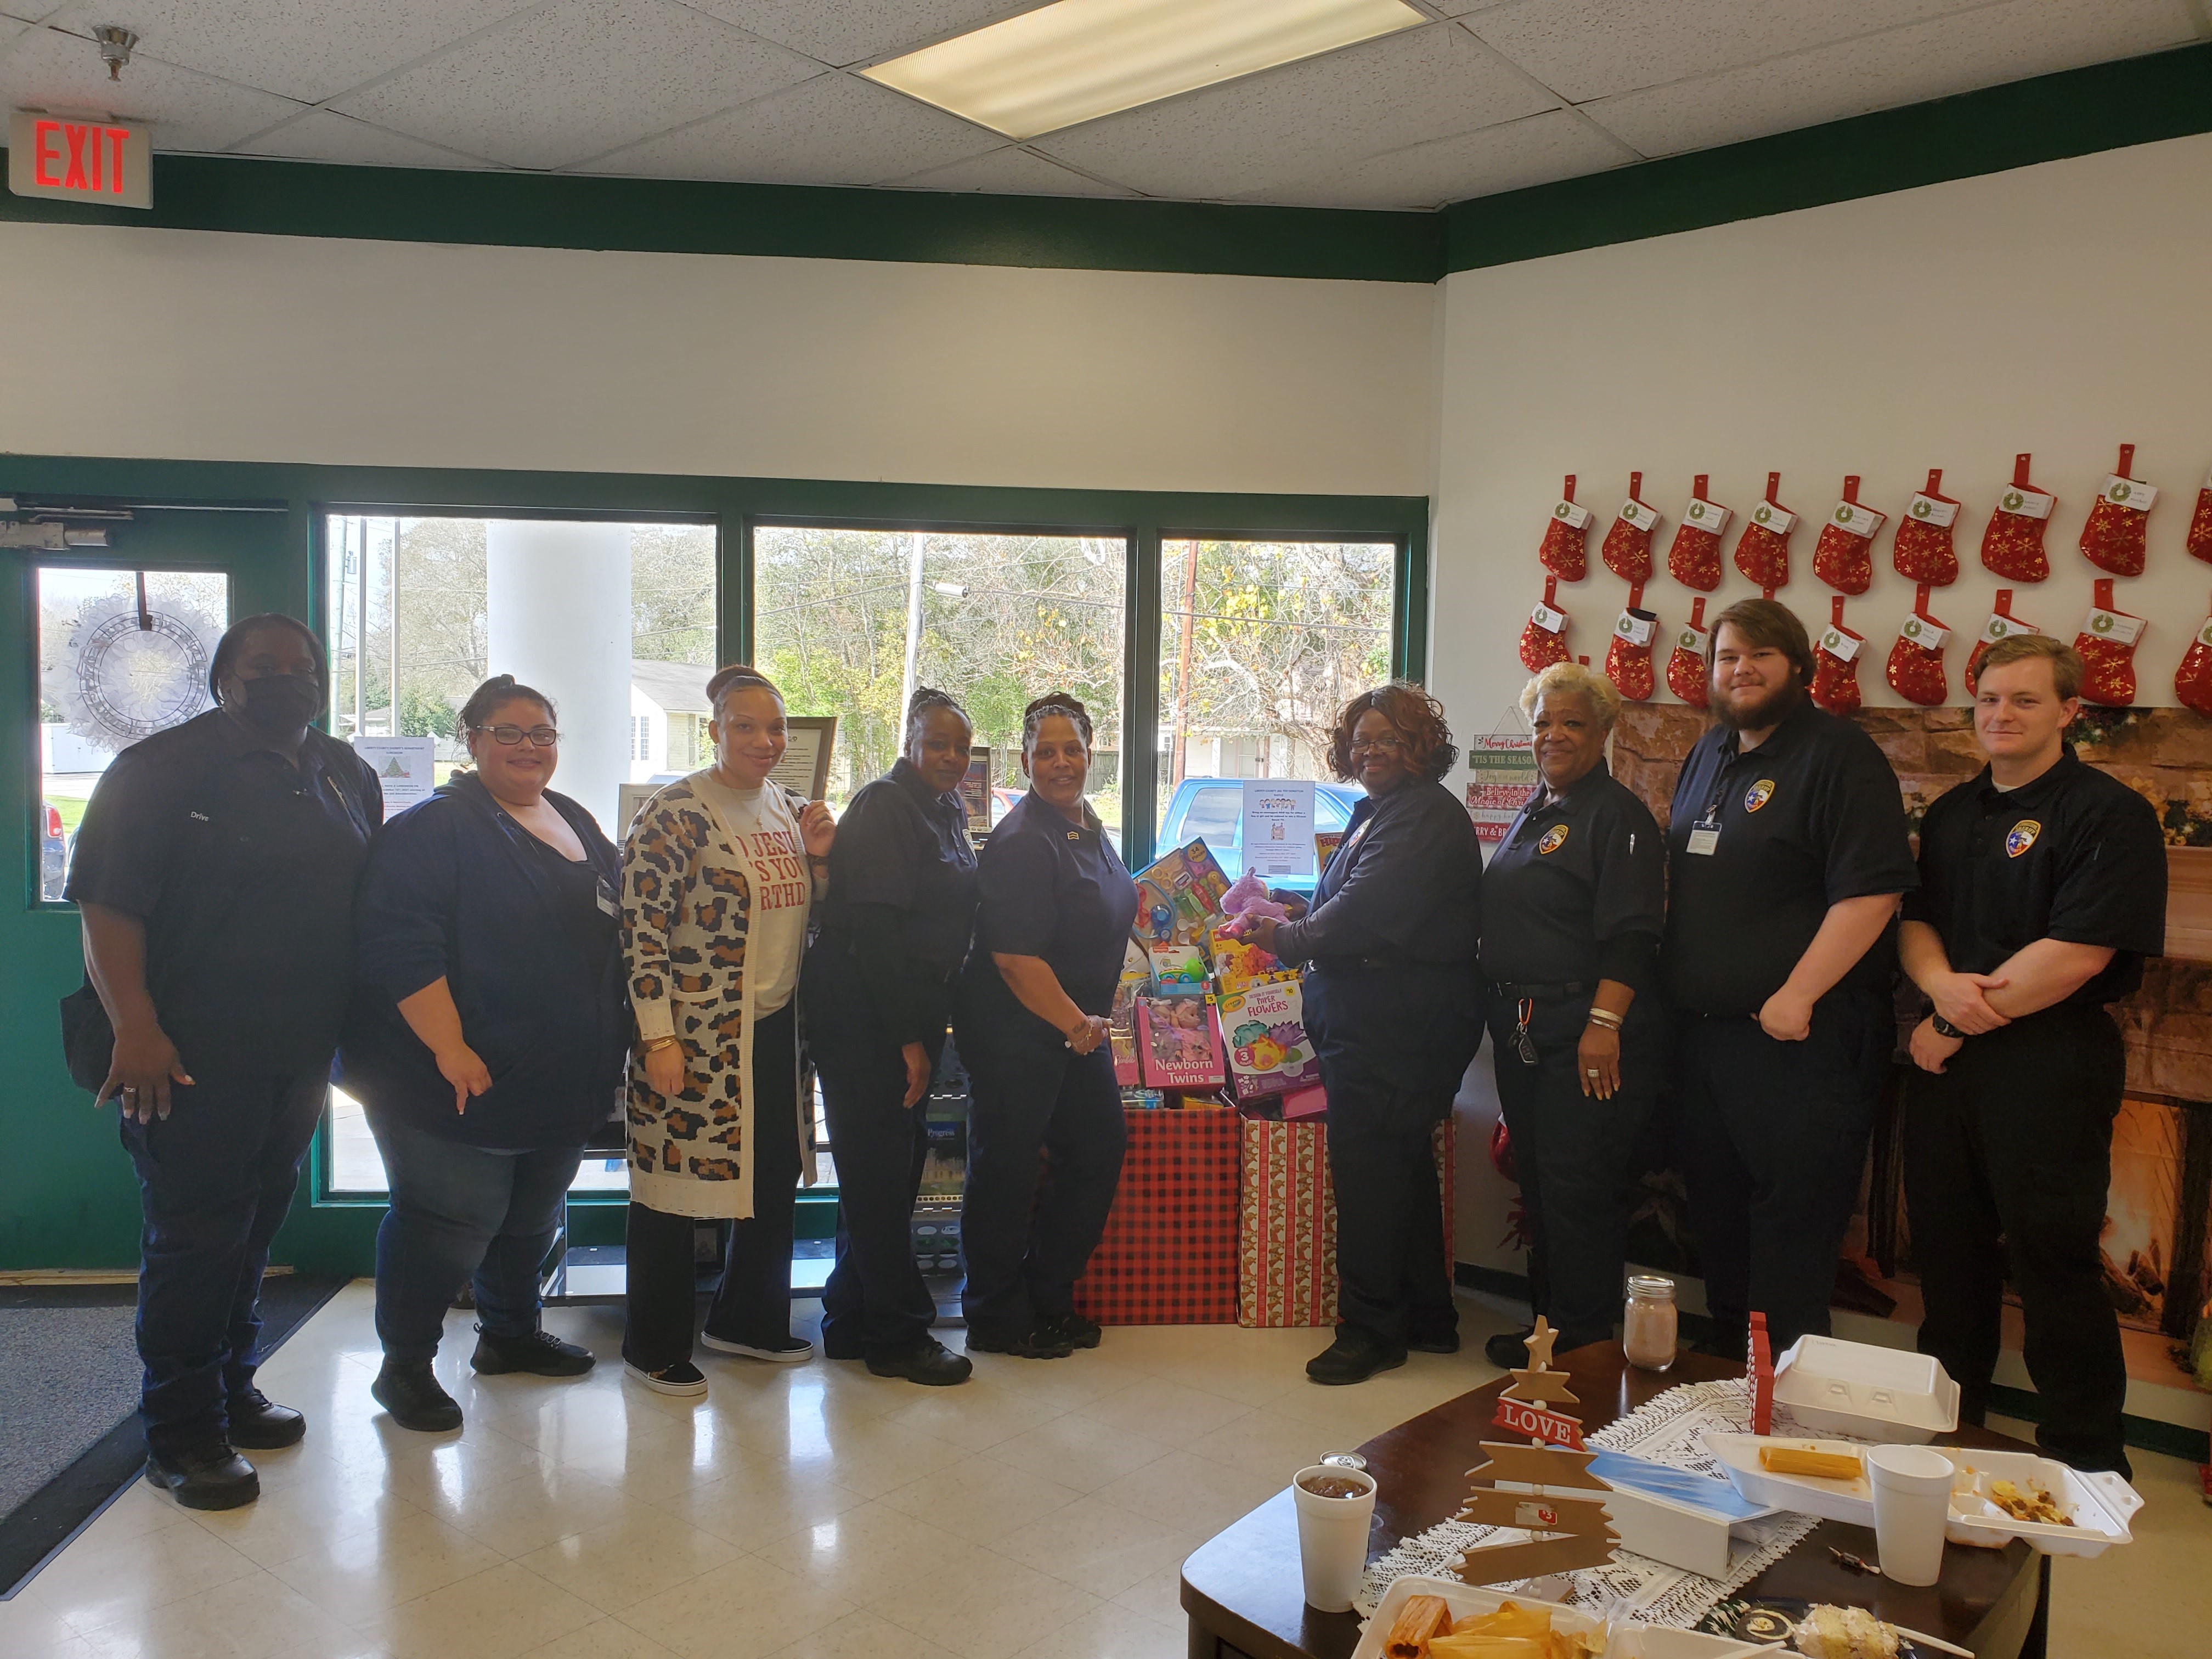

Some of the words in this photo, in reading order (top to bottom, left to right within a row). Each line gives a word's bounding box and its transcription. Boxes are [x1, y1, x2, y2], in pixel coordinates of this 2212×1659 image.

[35, 120, 129, 194] EXIT
[1482, 738, 1504, 750] Merry
[1489, 755, 1506, 764] THE
[1482, 770, 1496, 784] Joy
[1486, 787, 1511, 796] Believe
[1511, 788, 1518, 796] in
[1520, 788, 1530, 797] the
[1470, 796, 1496, 806] Magic
[1497, 798, 1505, 809] of
[1506, 797, 1524, 806] Chri
[1482, 812, 1501, 821] happy
[1474, 826, 1488, 836] RRY
[751, 831, 797, 857] JESU
[748, 860, 771, 882] 'S
[759, 882, 806, 910] RTHD
[1257, 995, 1276, 1005] PAPER
[1247, 1000, 1289, 1017] FLOWERS
[1240, 1052, 1249, 1061] 3
[1155, 1058, 1213, 1070] Newborn
[1167, 1072, 1204, 1084] Twins
[928, 1128, 955, 1138] Progress
[1504, 1404, 1571, 1443] LOVE
